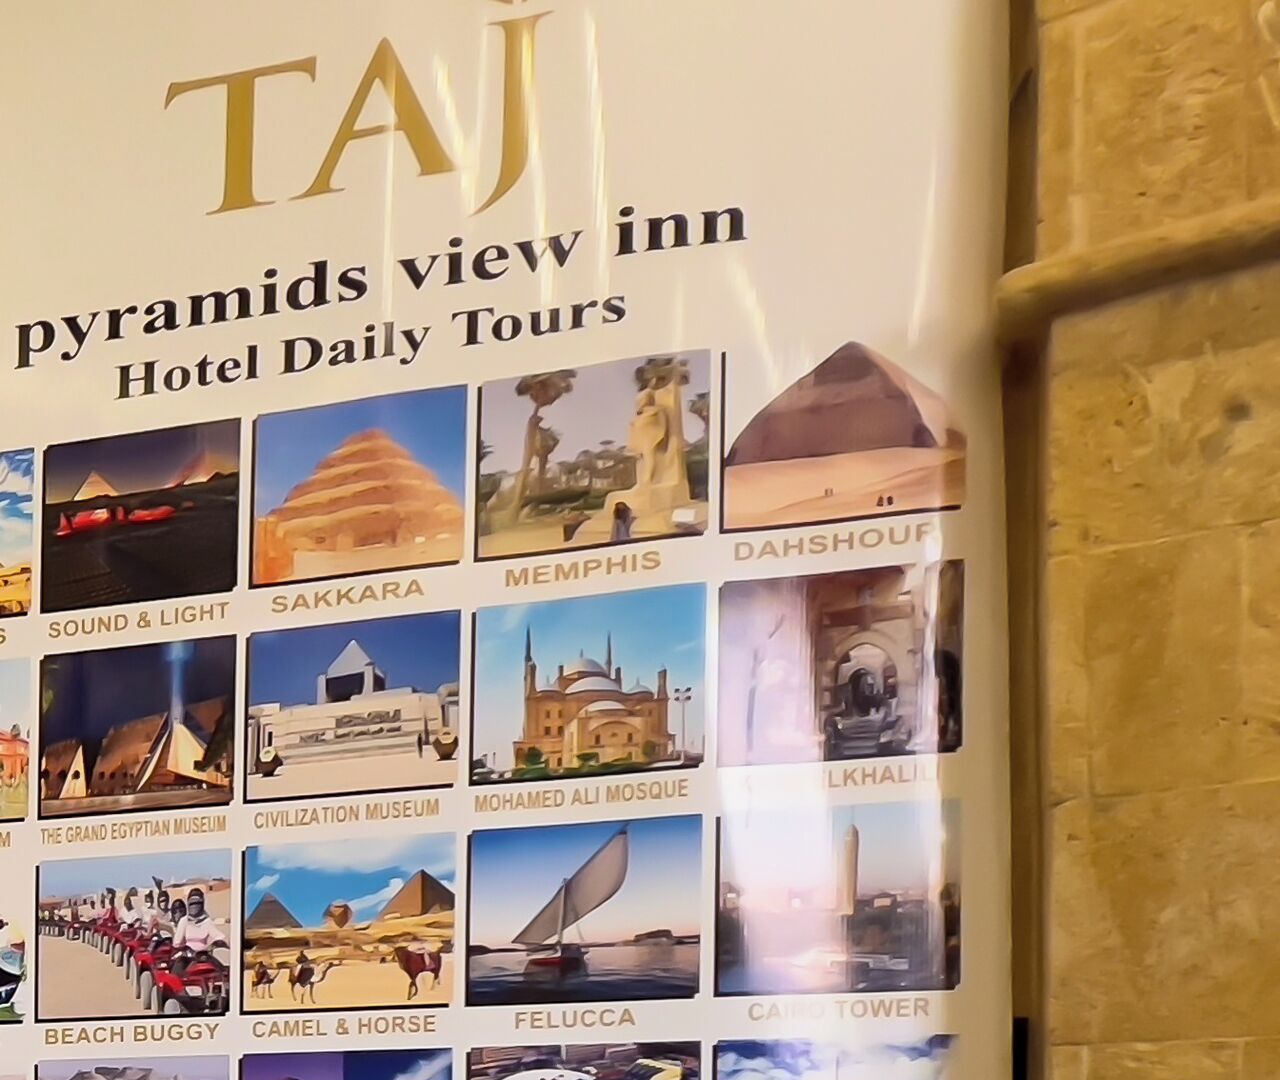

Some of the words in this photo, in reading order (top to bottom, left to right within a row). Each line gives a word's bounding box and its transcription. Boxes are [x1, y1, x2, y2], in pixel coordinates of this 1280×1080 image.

[164, 10, 554, 217] TAJ
[13, 257, 369, 370] pyramids
[398, 230, 582, 290] view
[615, 206, 746, 257] inn
[115, 344, 258, 400] Hotel
[280, 321, 431, 375] Daily
[451, 295, 626, 347] Tours
[504, 550, 662, 588] MEMPHIS
[270, 579, 425, 614] SAKKARA
[48, 613, 129, 639] SOUND
[136, 611, 152, 629] &
[160, 601, 230, 626] LIGHT
[474, 785, 566, 813] MOHAMED
[570, 786, 600, 806] ALI
[605, 775, 689, 803] MOSQUE
[40, 826, 63, 845] THE
[65, 823, 108, 844] GRAND
[110, 819, 171, 840] EGYPTIAN
[173, 815, 227, 835] MUSEUM
[253, 802, 360, 830] CIVILIZATION
[365, 797, 440, 821] MUSEUM
[514, 1008, 636, 1030] FELUCCA
[834, 997, 930, 1018] TOWER
[44, 1026, 125, 1045] BEACH
[133, 1023, 219, 1042] BUGGY
[252, 1019, 328, 1038] CAMEL
[335, 1017, 350, 1036] &
[358, 1014, 436, 1035] HORSE
